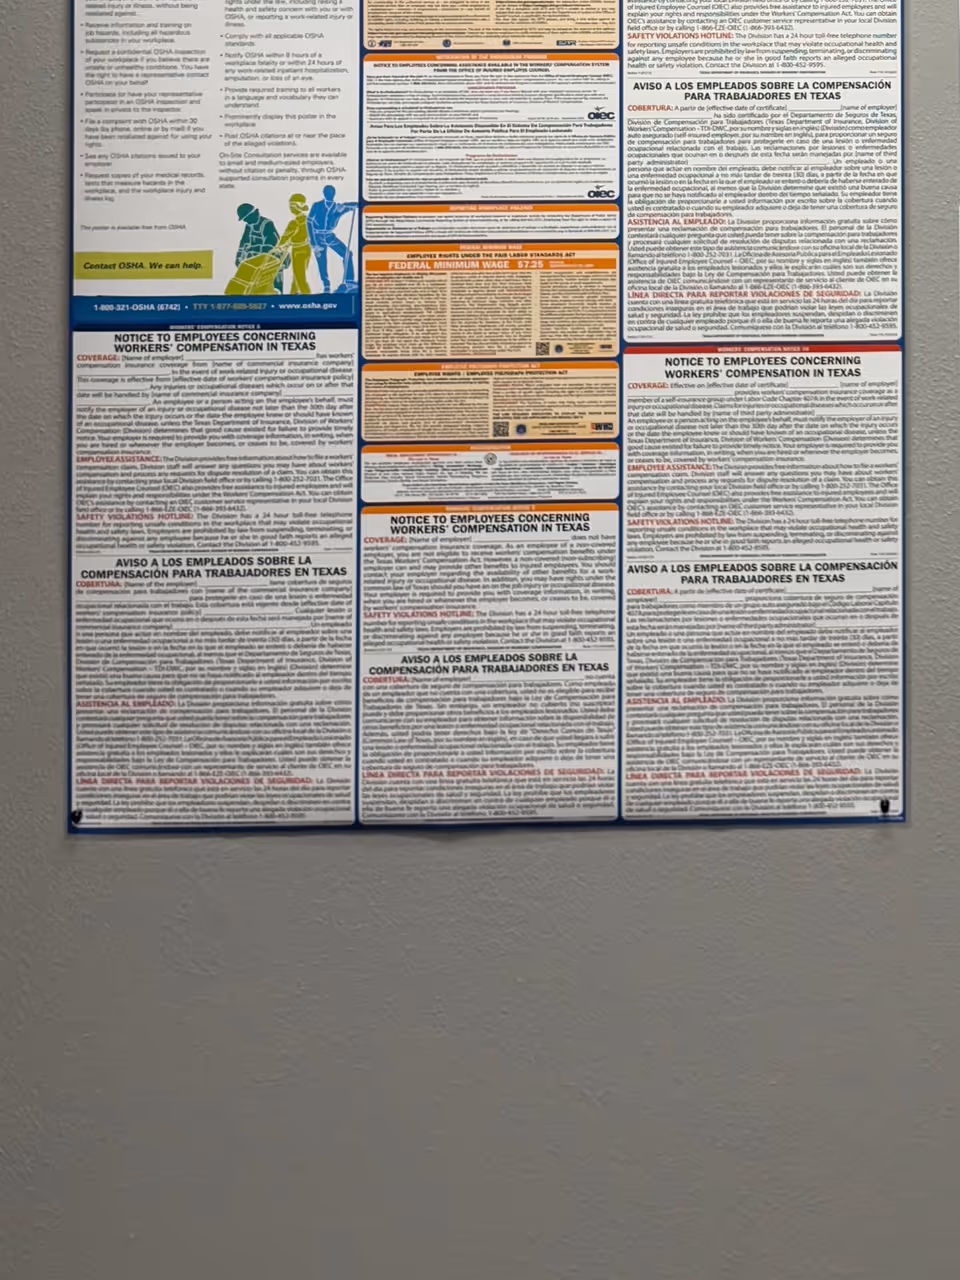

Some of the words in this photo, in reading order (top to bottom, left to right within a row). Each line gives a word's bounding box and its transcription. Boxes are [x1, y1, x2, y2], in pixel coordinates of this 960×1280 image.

[633, 81, 662, 90] AVISO
[664, 82, 672, 90] A
[674, 81, 693, 90] LOS
[696, 81, 757, 90] EMPLEADOS
[760, 81, 794, 89] SOBRE
[797, 81, 809, 89] LA
[812, 80, 891, 89] COMPENSACIÓN
[684, 92, 711, 100] PARA
[713, 92, 791, 100] TRABAJADORES
[794, 91, 807, 100] EN
[809, 91, 841, 100] TEXAS
[83, 261, 116, 270] Contact
[182, 261, 203, 270] help.
[388, 261, 431, 269] FEDERAL
[433, 260, 479, 269] MINIMUM
[481, 260, 509, 269] WAGE
[517, 260, 543, 268] $7.25
[278, 302, 337, 310] www.osha.gov
[114, 333, 154, 343] NOTICE
[156, 333, 171, 342] TO
[174, 332, 240, 342] EMPLOYEES
[242, 331, 315, 341] CONCERNING
[113, 343, 172, 353] WORKERS'
[176, 342, 263, 352] COMPENSATION
[266, 342, 278, 351] IN
[280, 341, 316, 351] TEXAS
[665, 357, 704, 366] NOTICE
[706, 357, 720, 366] TO
[723, 356, 787, 365] EMPLOYEES
[790, 356, 861, 365] CONCERNING
[664, 369, 722, 379] WORKERS'
[725, 368, 810, 378] COMPENSATION
[813, 368, 824, 377] IN
[827, 368, 861, 377] TEXAS
[390, 515, 430, 524] NOTICE
[432, 515, 447, 524] TO
[450, 514, 515, 524] EMPLOYEES
[517, 513, 589, 522] CONCERNING
[390, 524, 448, 534] WORKERS'
[452, 523, 538, 533] COMPENSATION
[541, 523, 552, 532] IN
[555, 522, 590, 532] TEXAS
[115, 558, 148, 568] AVISO
[150, 558, 159, 567] A
[161, 557, 182, 567] LOS
[185, 556, 254, 566] EMPLEADOS
[257, 556, 295, 565] SOBRE
[298, 556, 312, 565] LA
[80, 569, 169, 579] COMPENSACIÓN
[172, 568, 202, 578] PARA
[204, 567, 291, 578] TRABAJADORES
[294, 567, 309, 576] EN
[312, 566, 347, 576] TEXAS
